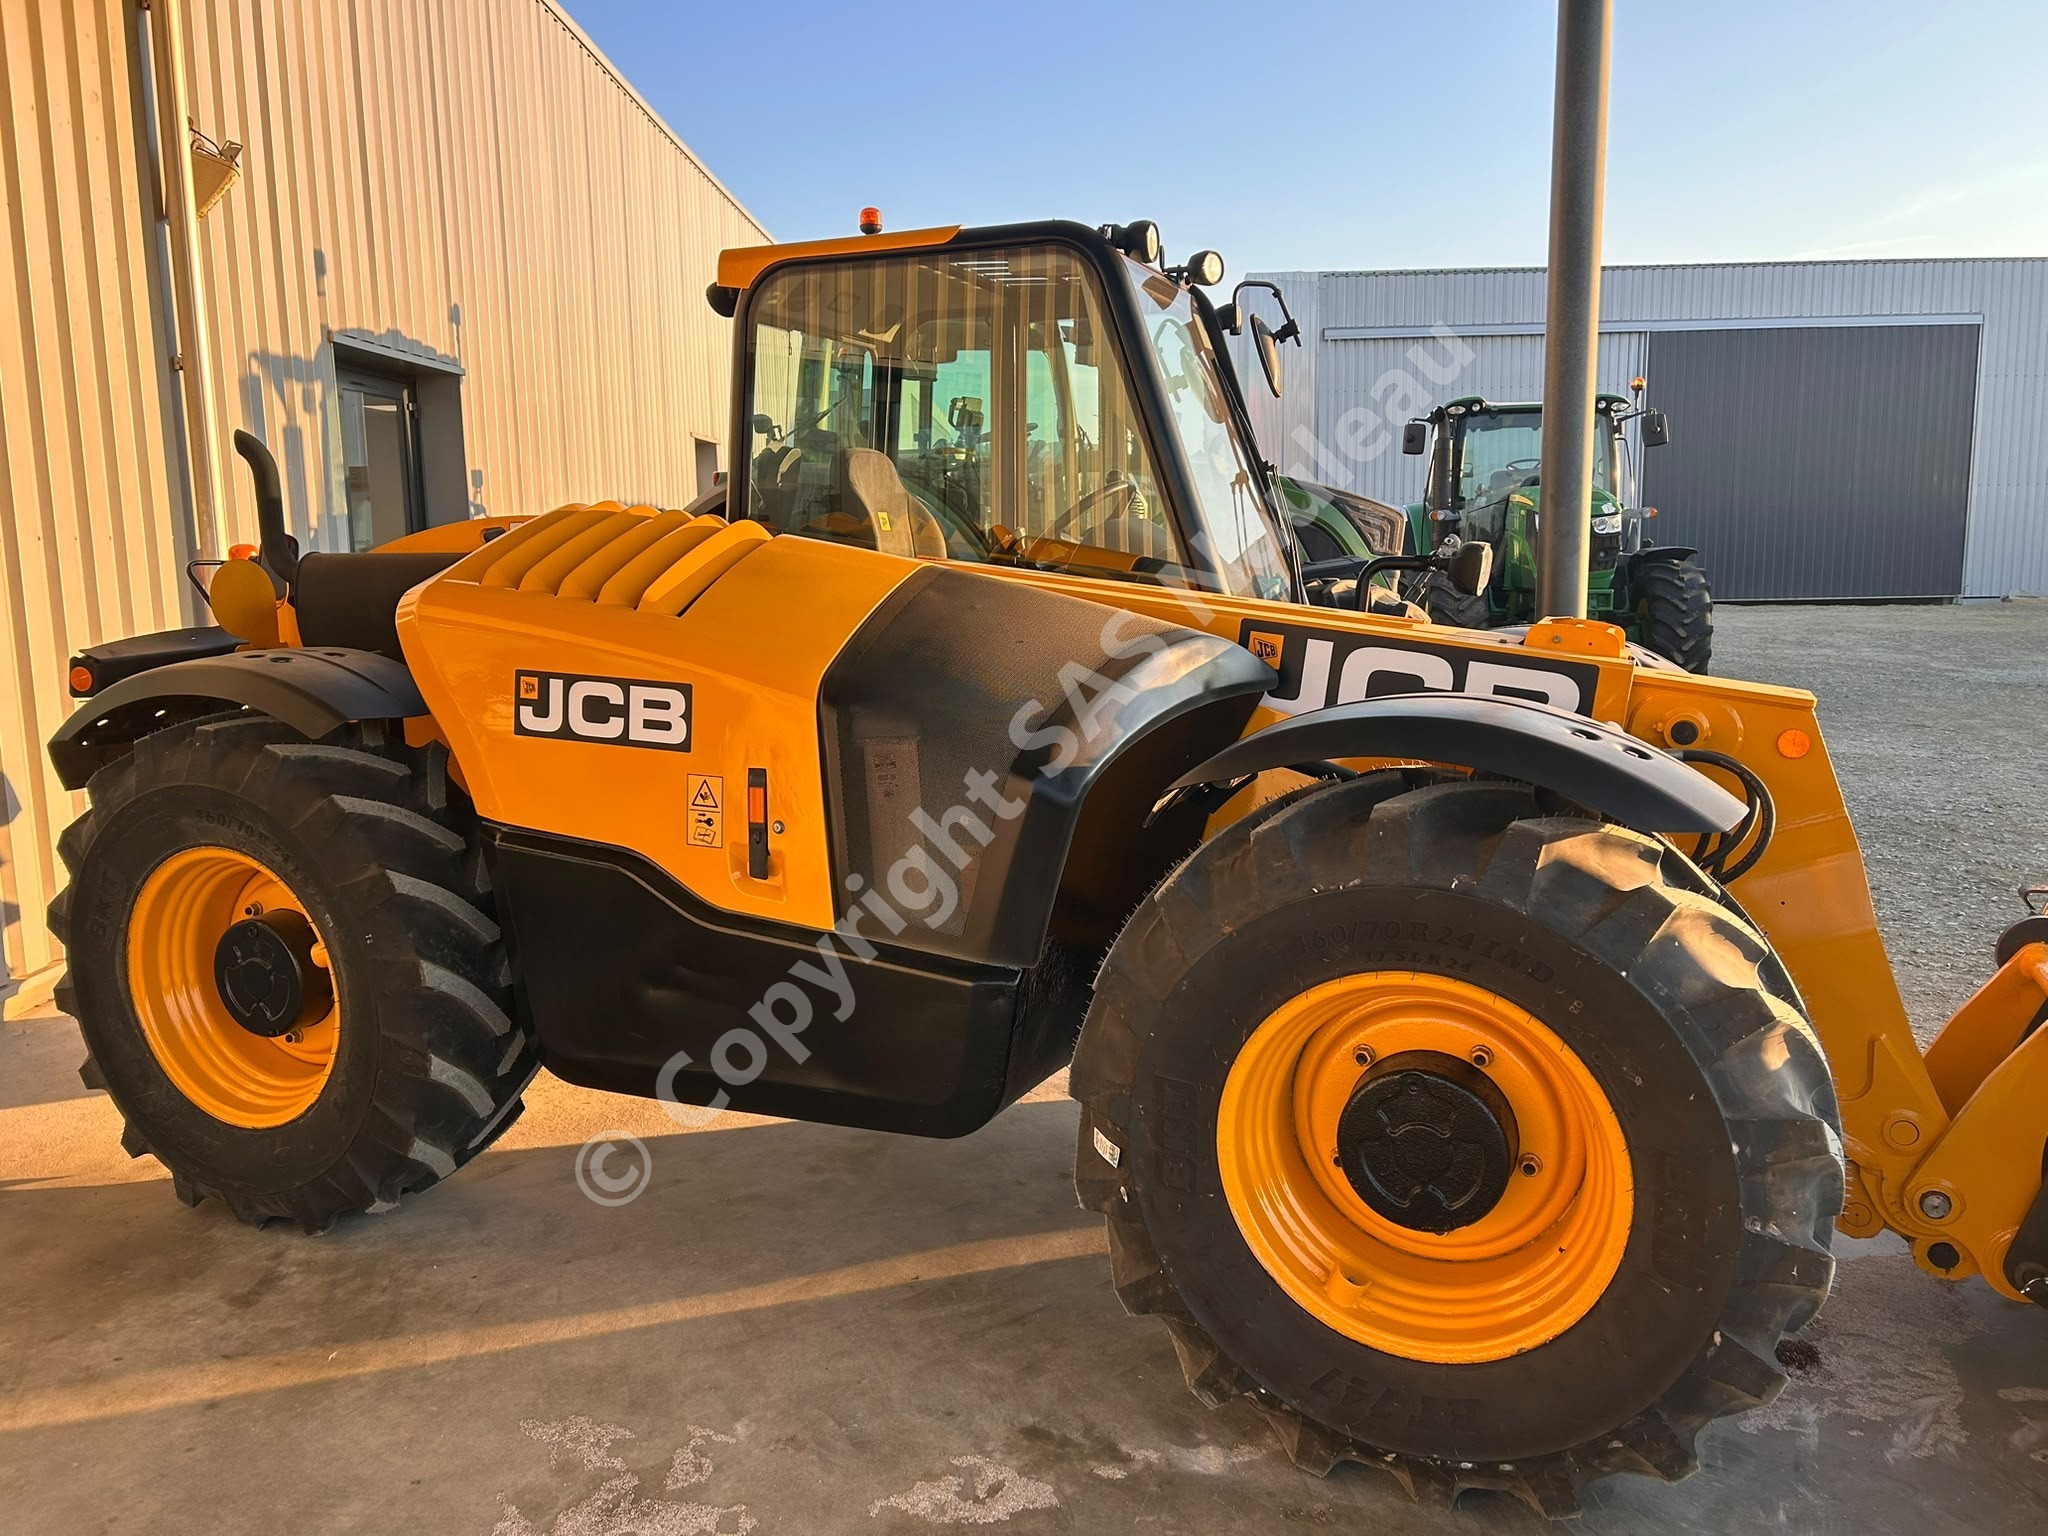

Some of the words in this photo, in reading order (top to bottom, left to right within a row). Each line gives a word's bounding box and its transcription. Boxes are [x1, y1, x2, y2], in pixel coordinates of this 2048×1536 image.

[1257, 640, 1276, 657] JCB
[1264, 638, 1581, 720] JCB
[519, 678, 687, 745] JCB
